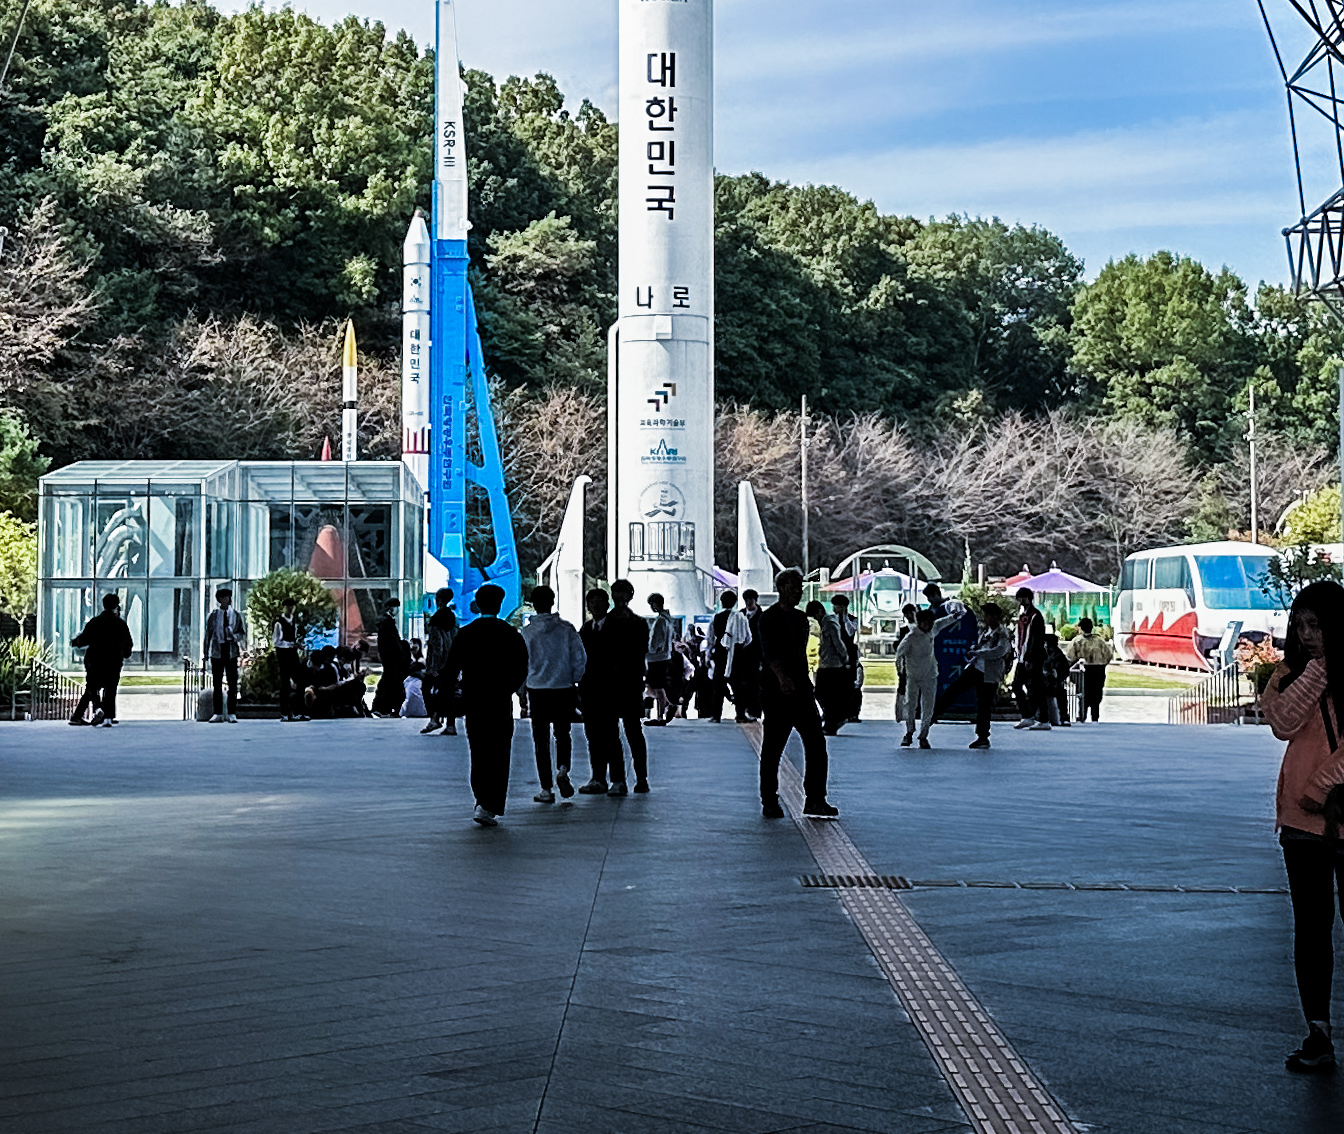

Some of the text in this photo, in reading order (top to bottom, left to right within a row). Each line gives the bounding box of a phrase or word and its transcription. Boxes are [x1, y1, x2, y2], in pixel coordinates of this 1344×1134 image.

[443, 121, 456, 167] KSR-III
[646, 52, 677, 220] 대한민국
[410, 329, 420, 385] 대한민국
